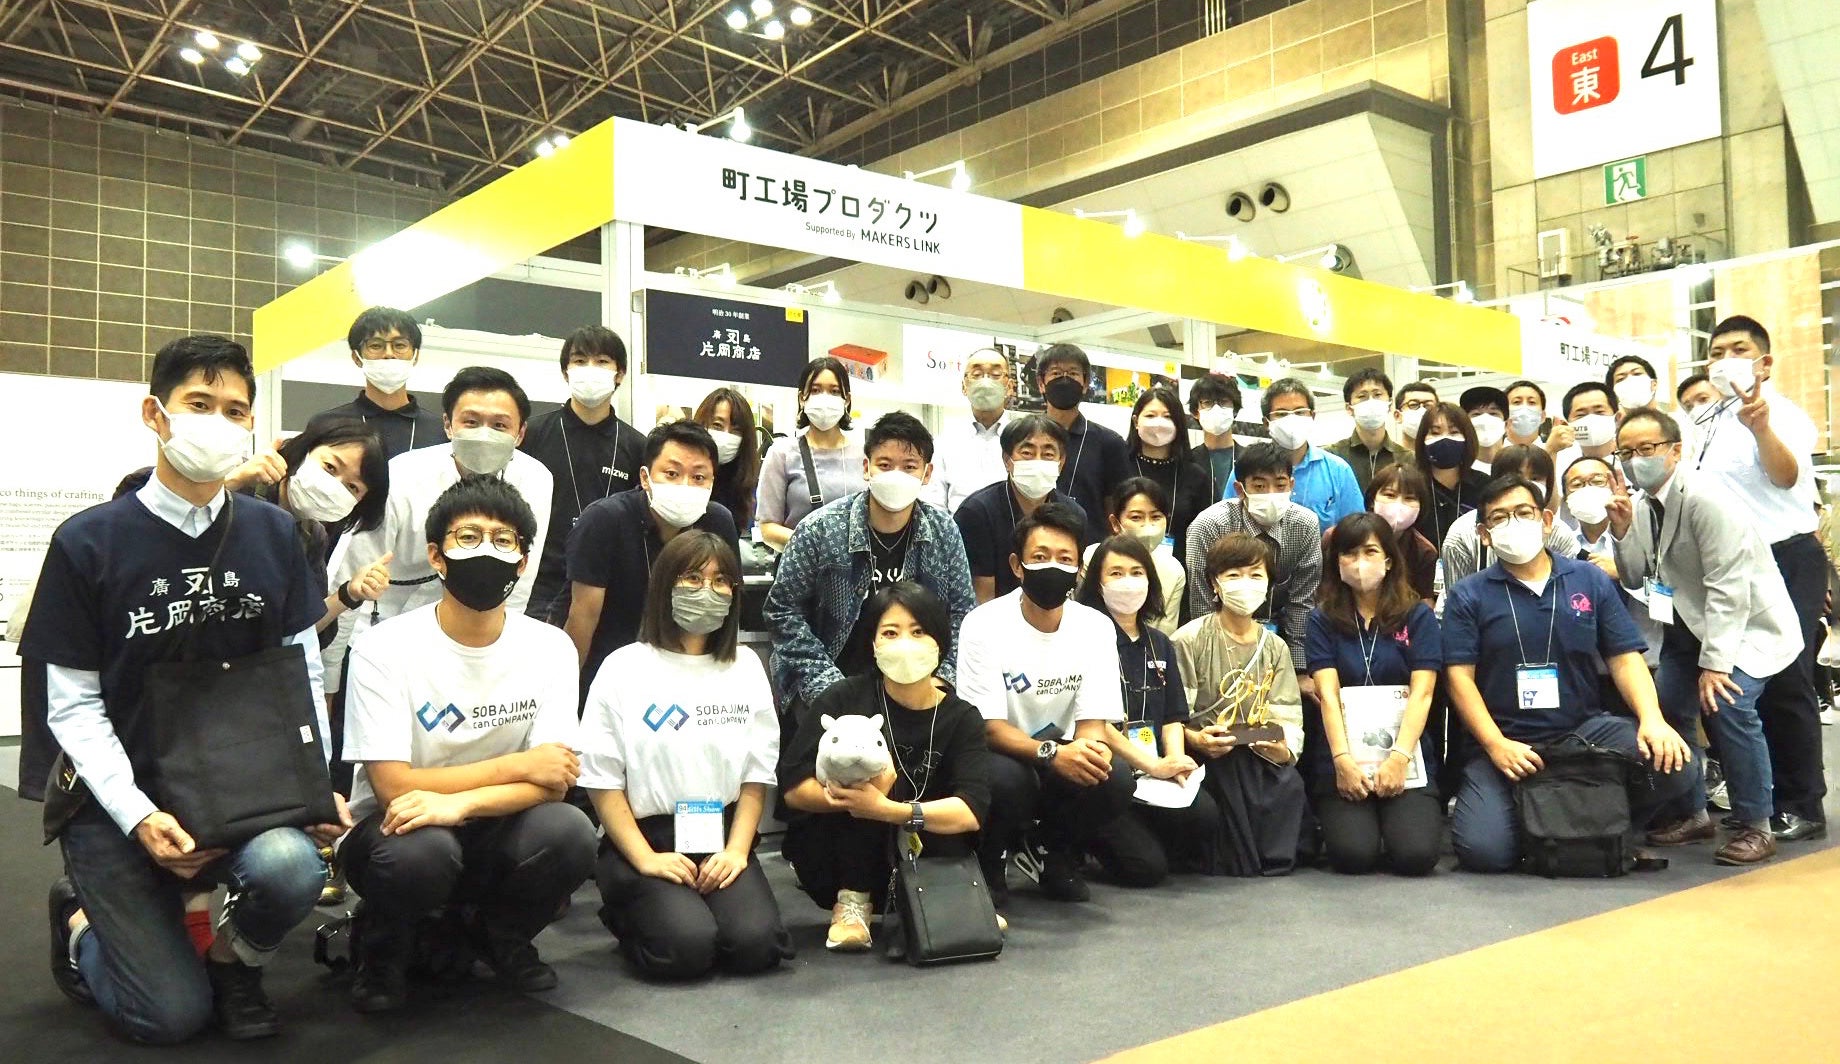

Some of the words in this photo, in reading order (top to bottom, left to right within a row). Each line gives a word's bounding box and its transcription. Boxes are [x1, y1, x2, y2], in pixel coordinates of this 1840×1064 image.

[1571, 48, 1598, 66] East
[1641, 13, 1694, 86] 4
[1570, 66, 1601, 106] 東
[722, 167, 938, 234] 町工場プロダクツ
[805, 222, 845, 238] Supported
[846, 228, 856, 240] By
[861, 228, 910, 249] MAKERS
[913, 238, 941, 254] LINK
[699, 340, 762, 361] 片岡商店
[15, 487, 49, 501] things
[50, 488, 62, 498] of
[64, 490, 105, 502] crafting
[125, 593, 266, 640] 片岡商店
[472, 699, 537, 719] SOBAJIMA
[695, 704, 750, 717] SOBAJIMA
